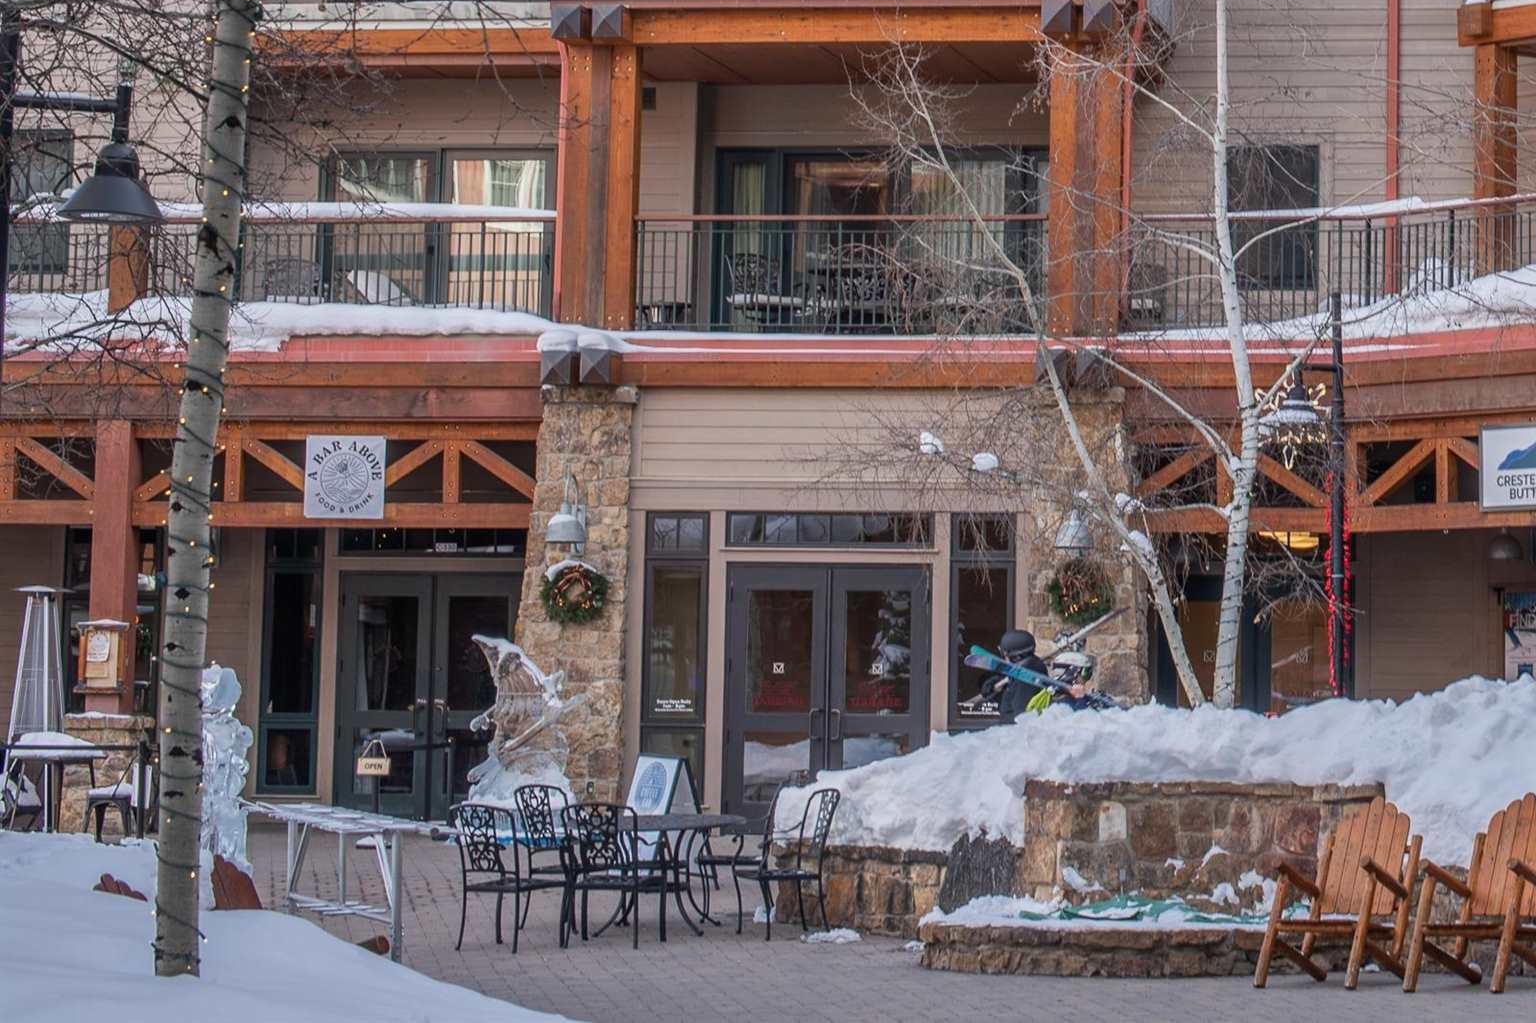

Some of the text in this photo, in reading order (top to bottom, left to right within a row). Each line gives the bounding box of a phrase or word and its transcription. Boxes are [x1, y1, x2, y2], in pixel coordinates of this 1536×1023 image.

[308, 440, 383, 481] A BAR ABOVE
[314, 491, 336, 512] FOOD
[348, 492, 375, 514] DRINK
[364, 762, 383, 770] OPEN
